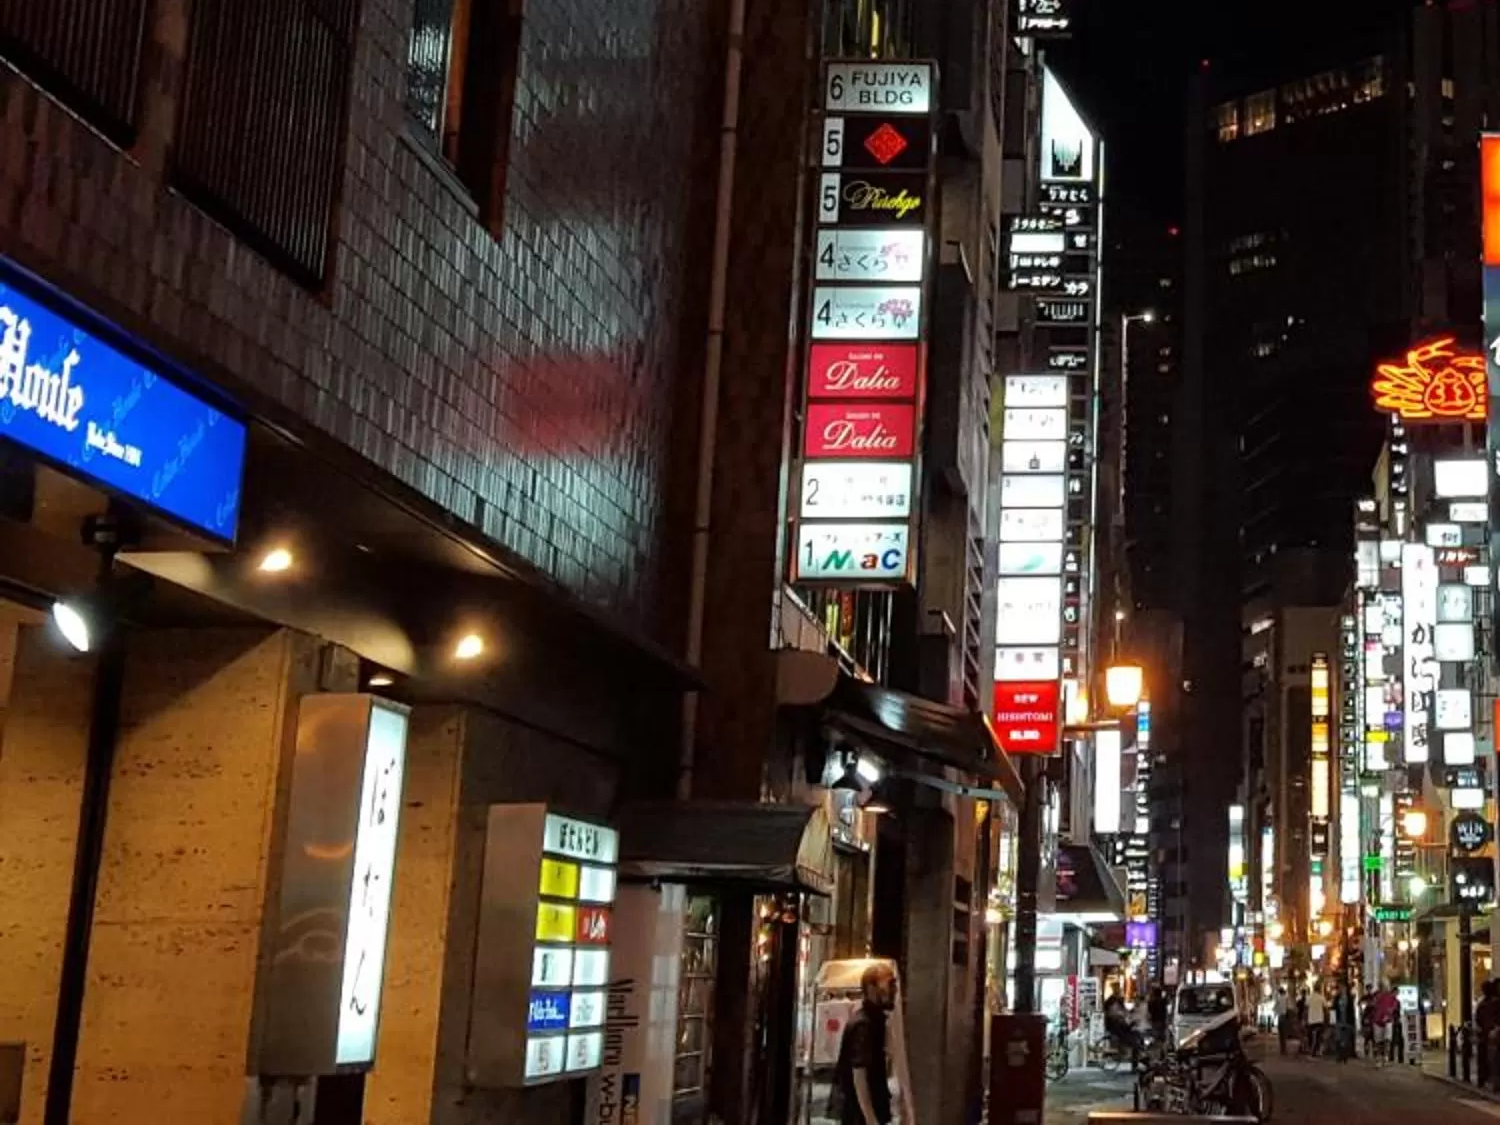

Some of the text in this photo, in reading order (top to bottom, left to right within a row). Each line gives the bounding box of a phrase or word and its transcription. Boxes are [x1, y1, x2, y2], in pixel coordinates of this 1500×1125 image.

[830, 71, 922, 100] 6 FUJIYA
[859, 90, 913, 104] BLDG
[827, 130, 840, 155] 5
[823, 186, 837, 211] 5
[820, 242, 834, 268] 4
[817, 299, 831, 326] 4
[824, 361, 901, 390] Dalia
[822, 420, 897, 449] Dalia
[806, 478, 819, 506] 2
[805, 539, 813, 567] 1
